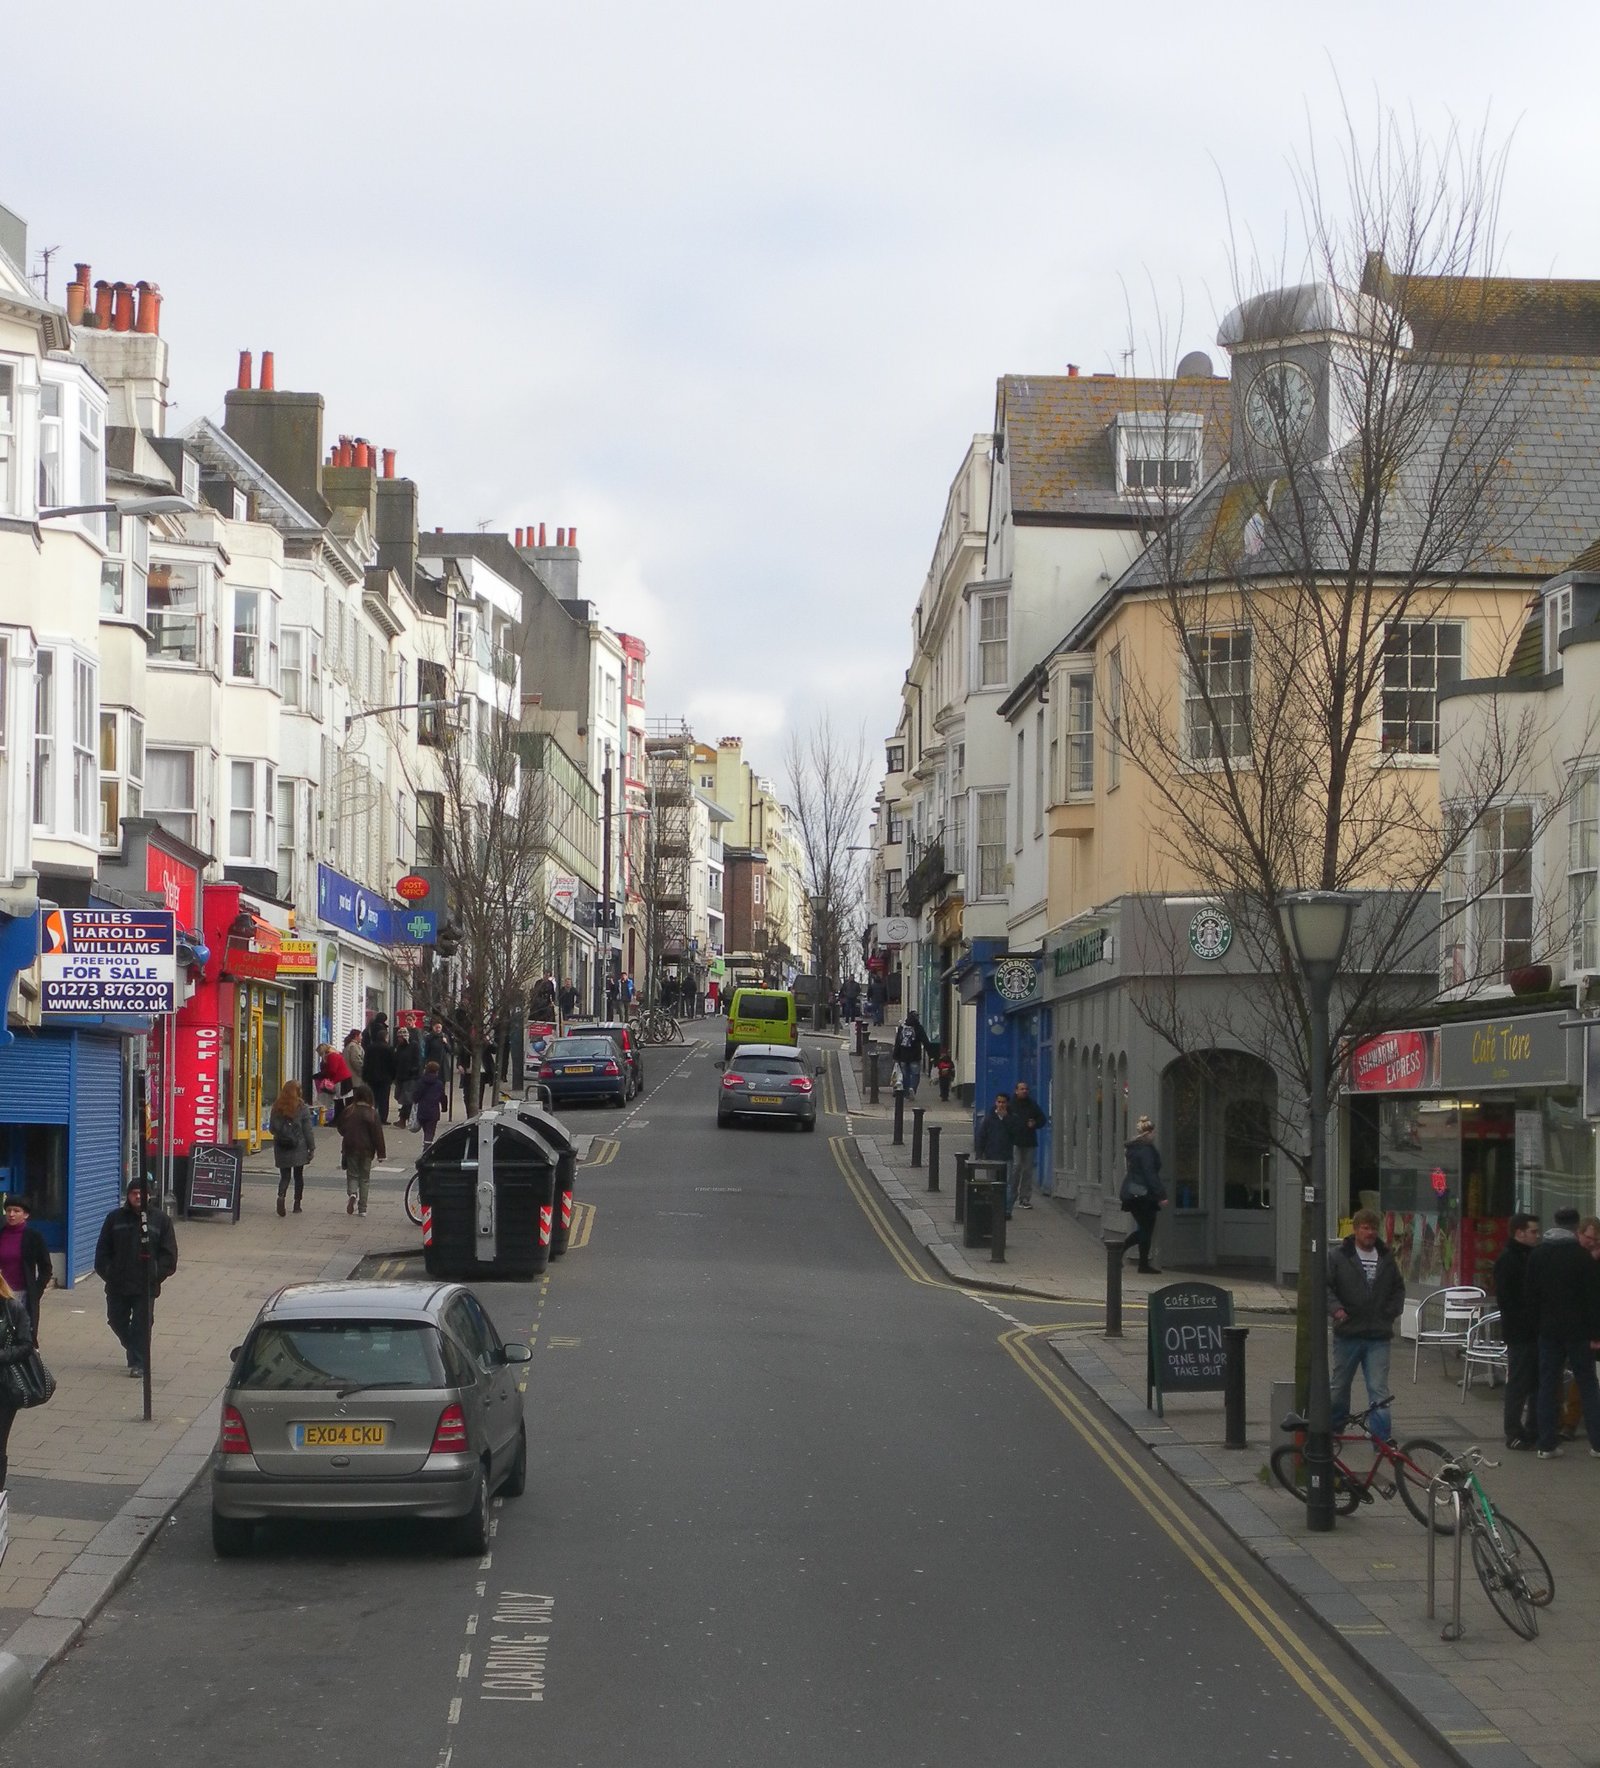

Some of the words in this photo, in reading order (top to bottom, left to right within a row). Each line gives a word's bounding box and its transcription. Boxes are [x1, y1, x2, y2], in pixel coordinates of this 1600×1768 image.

[404, 881, 423, 889] POST
[72, 912, 132, 924] STILES
[1191, 909, 1231, 931] STARBUCKS
[73, 927, 146, 939] HAROLD
[73, 942, 160, 954] WILLIAMS
[1194, 943, 1224, 957] COFFEE
[73, 956, 140, 966] FREEHOLD
[242, 954, 263, 964] OFF
[62, 966, 101, 979] FOR
[109, 967, 158, 980] SALE
[228, 962, 274, 977] LICENCE
[997, 960, 1036, 979] STARBUCKS
[47, 983, 99, 996] 01273
[104, 983, 168, 997] 876200
[1001, 988, 1031, 1000] COFFEE
[47, 997, 168, 1010] www.shw.co.uk
[195, 1029, 218, 1060] OFF
[1472, 1024, 1497, 1065] Café
[1500, 1023, 1531, 1062] Tiere
[1358, 1038, 1400, 1076] SHAWARMA
[1386, 1049, 1422, 1086] EXPRESS
[194, 1073, 216, 1144] LICENC
[1165, 1325, 1223, 1351] OPEN
[1168, 1353, 1196, 1366] DINE
[1198, 1352, 1210, 1364] IN
[1213, 1352, 1228, 1366] OR
[1174, 1366, 1200, 1376] TAKE
[1202, 1366, 1222, 1376] OUT
[306, 1427, 348, 1444] EX04
[351, 1426, 383, 1444] CKU
[492, 1591, 555, 1624] ONLY
[480, 1635, 550, 1701] LOADING
